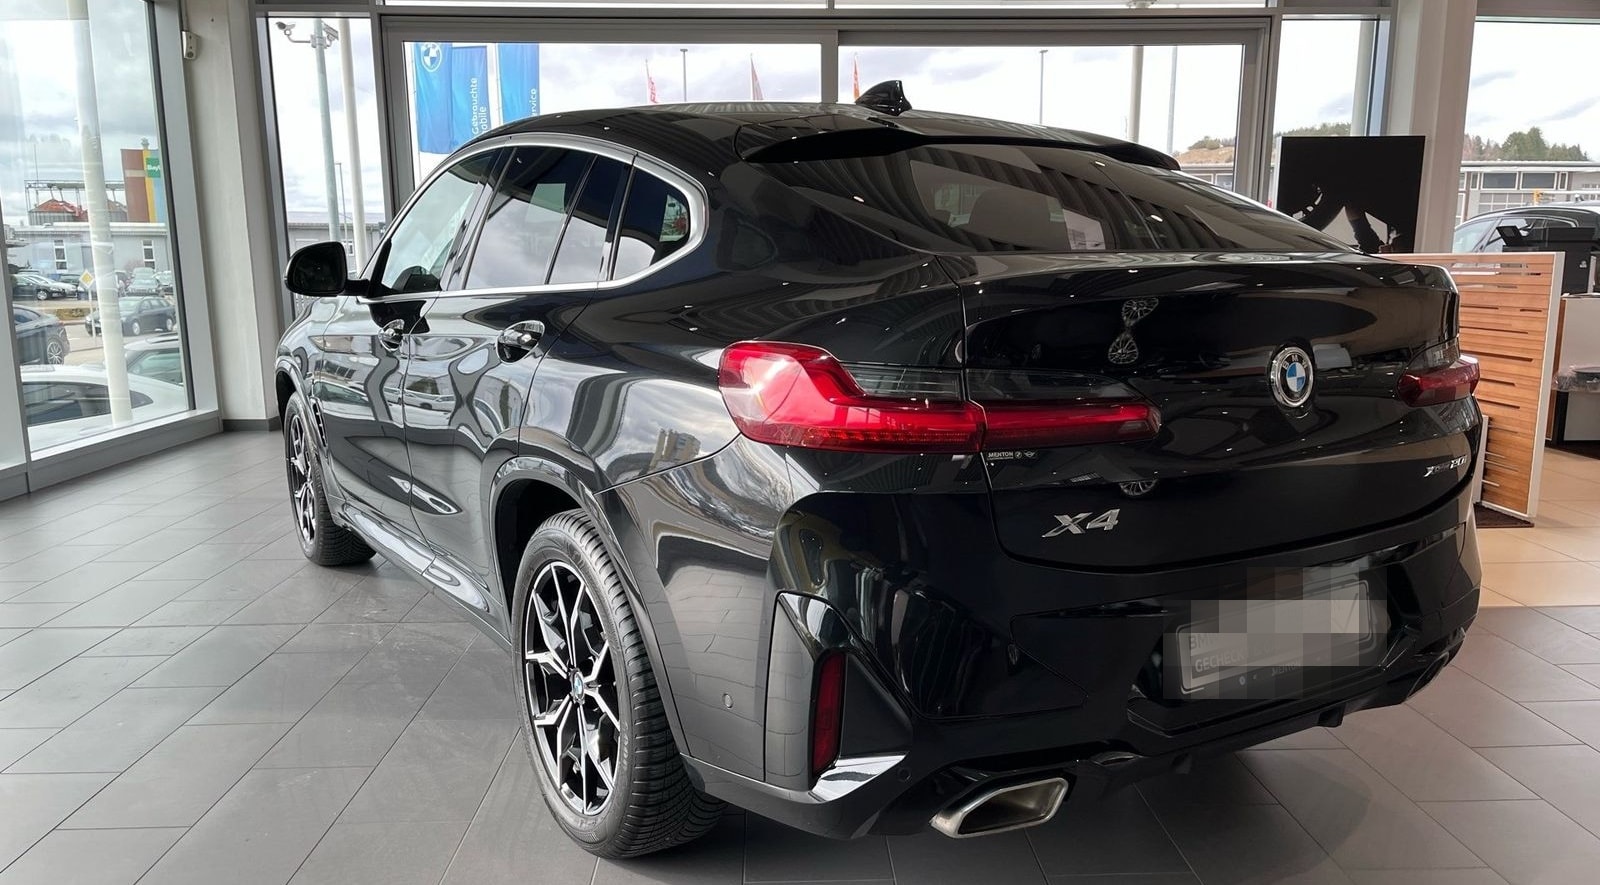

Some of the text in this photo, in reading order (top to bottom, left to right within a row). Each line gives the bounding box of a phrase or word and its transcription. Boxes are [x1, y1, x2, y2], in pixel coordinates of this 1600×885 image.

[470, 77, 479, 135] Gebrauchte
[478, 106, 488, 133] obile
[1281, 354, 1308, 370] BMW
[1041, 508, 1120, 538] X4
